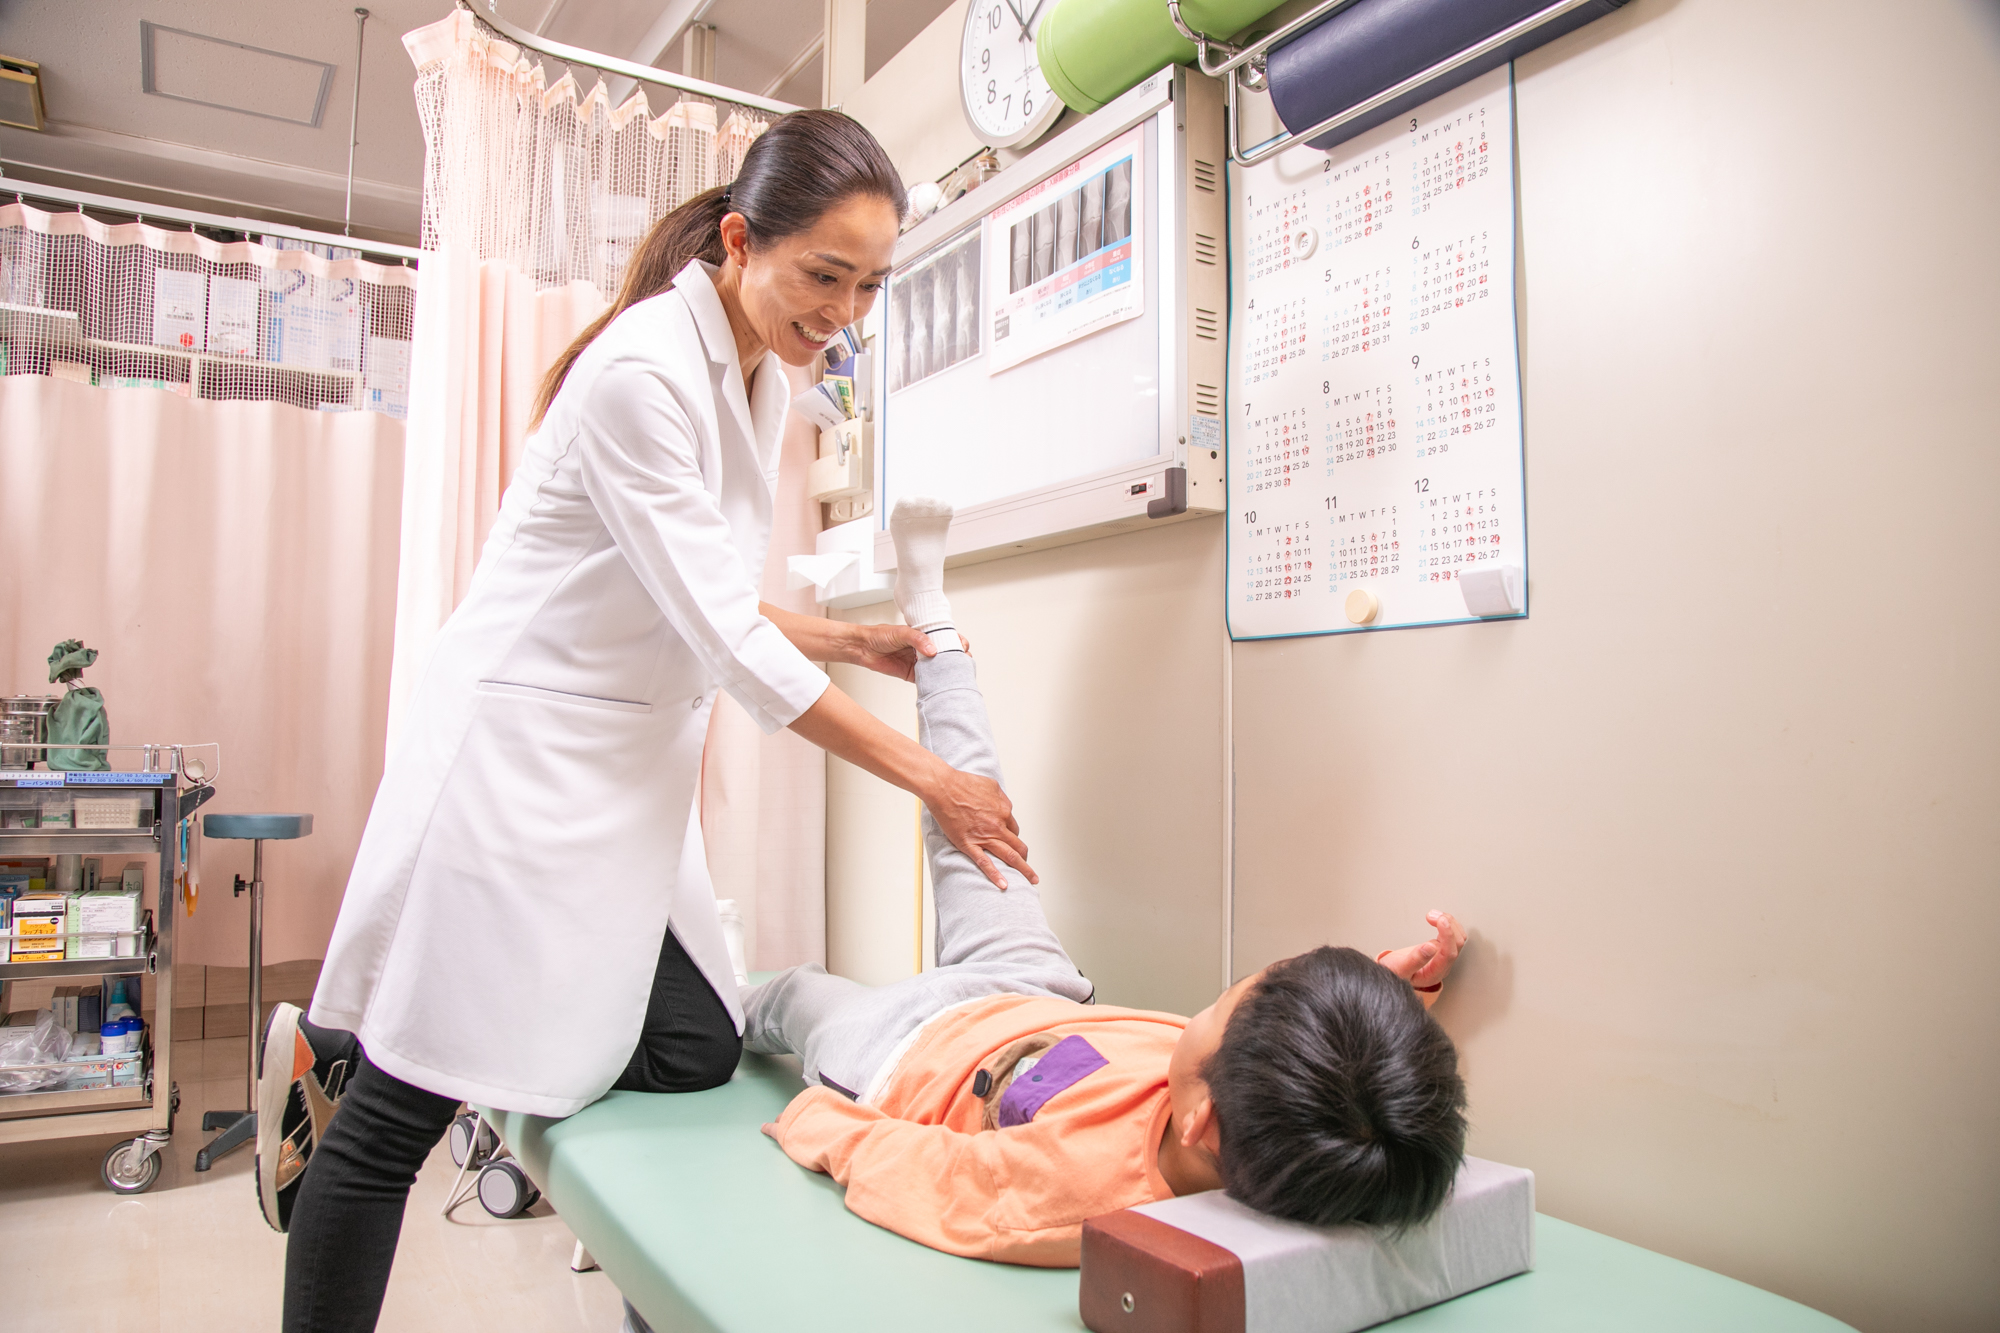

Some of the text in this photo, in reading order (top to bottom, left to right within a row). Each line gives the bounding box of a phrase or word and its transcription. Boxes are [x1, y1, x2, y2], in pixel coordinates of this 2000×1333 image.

[987, 5, 1001, 34] 10
[982, 48, 990, 73] 9
[987, 80, 996, 104] 8
[1003, 94, 1011, 120] 7
[1023, 90, 1032, 116] 6
[1410, 118, 1417, 132] 3
[1422, 133, 1428, 142] M
[1444, 123, 1451, 132] W
[1456, 118, 1461, 126] T
[1469, 113, 1473, 121] F
[1480, 108, 1485, 116] S
[1324, 159, 1331, 172] 2
[1423, 191, 1431, 200] 24
[1434, 186, 1442, 196] 25
[1445, 182, 1454, 191] 26
[1468, 172, 1476, 182] 28
[1480, 166, 1488, 177] 29
[1248, 195, 1252, 206] 1
[1335, 225, 1342, 234] 17
[1345, 221, 1352, 230] 18
[1355, 217, 1362, 226] 19
[1375, 209, 1381, 218] 21
[1385, 204, 1392, 214] 22
[1412, 236, 1420, 249] 6
[1445, 244, 1453, 252] W
[1471, 235, 1475, 244] F
[1483, 231, 1487, 239] S
[1257, 270, 1264, 278] 27
[1266, 266, 1272, 274] 28
[1275, 263, 1282, 271] 29
[1325, 269, 1331, 282] 5
[1248, 299, 1254, 309] 4
[1421, 308, 1429, 317] 23
[1432, 304, 1440, 313] 24
[1444, 300, 1452, 310] 25
[1467, 292, 1476, 302] 27
[1479, 289, 1488, 298] 28
[1332, 337, 1339, 345] 19
[1342, 334, 1349, 342] 20
[1352, 330, 1358, 339] 21
[1372, 324, 1380, 332] 23
[1383, 320, 1390, 329] 24
[1412, 355, 1420, 369] 9
[1425, 374, 1432, 382] M
[1437, 370, 1442, 378] T
[1447, 367, 1455, 376] W
[1461, 364, 1465, 372] T
[1473, 361, 1477, 369] F
[1485, 358, 1490, 366] S
[1323, 381, 1330, 394] 8
[1245, 403, 1251, 416] 7
[1428, 432, 1436, 441] 22
[1451, 426, 1459, 435] 24
[1474, 421, 1484, 430] 26
[1487, 418, 1496, 428] 27
[1336, 443, 1343, 451] 18
[1346, 441, 1353, 449] 19
[1356, 438, 1364, 447] 20
[1377, 434, 1385, 442] 22
[1388, 431, 1396, 440] 23
[1293, 462, 1300, 470] 25
[1415, 478, 1429, 493] 12
[1466, 492, 1471, 500] T
[1479, 490, 1483, 498] F
[1491, 488, 1496, 496] S
[1325, 496, 1336, 510] 11
[1245, 511, 1256, 524] 10
[1430, 557, 1438, 566] 22
[1442, 556, 1450, 564] 23
[1454, 554, 1463, 563] 24
[1478, 551, 1488, 560] 26
[1491, 549, 1500, 558] 27
[1350, 571, 1358, 579] 25
[1381, 566, 1389, 575] 28
[1392, 565, 1399, 573] 29
